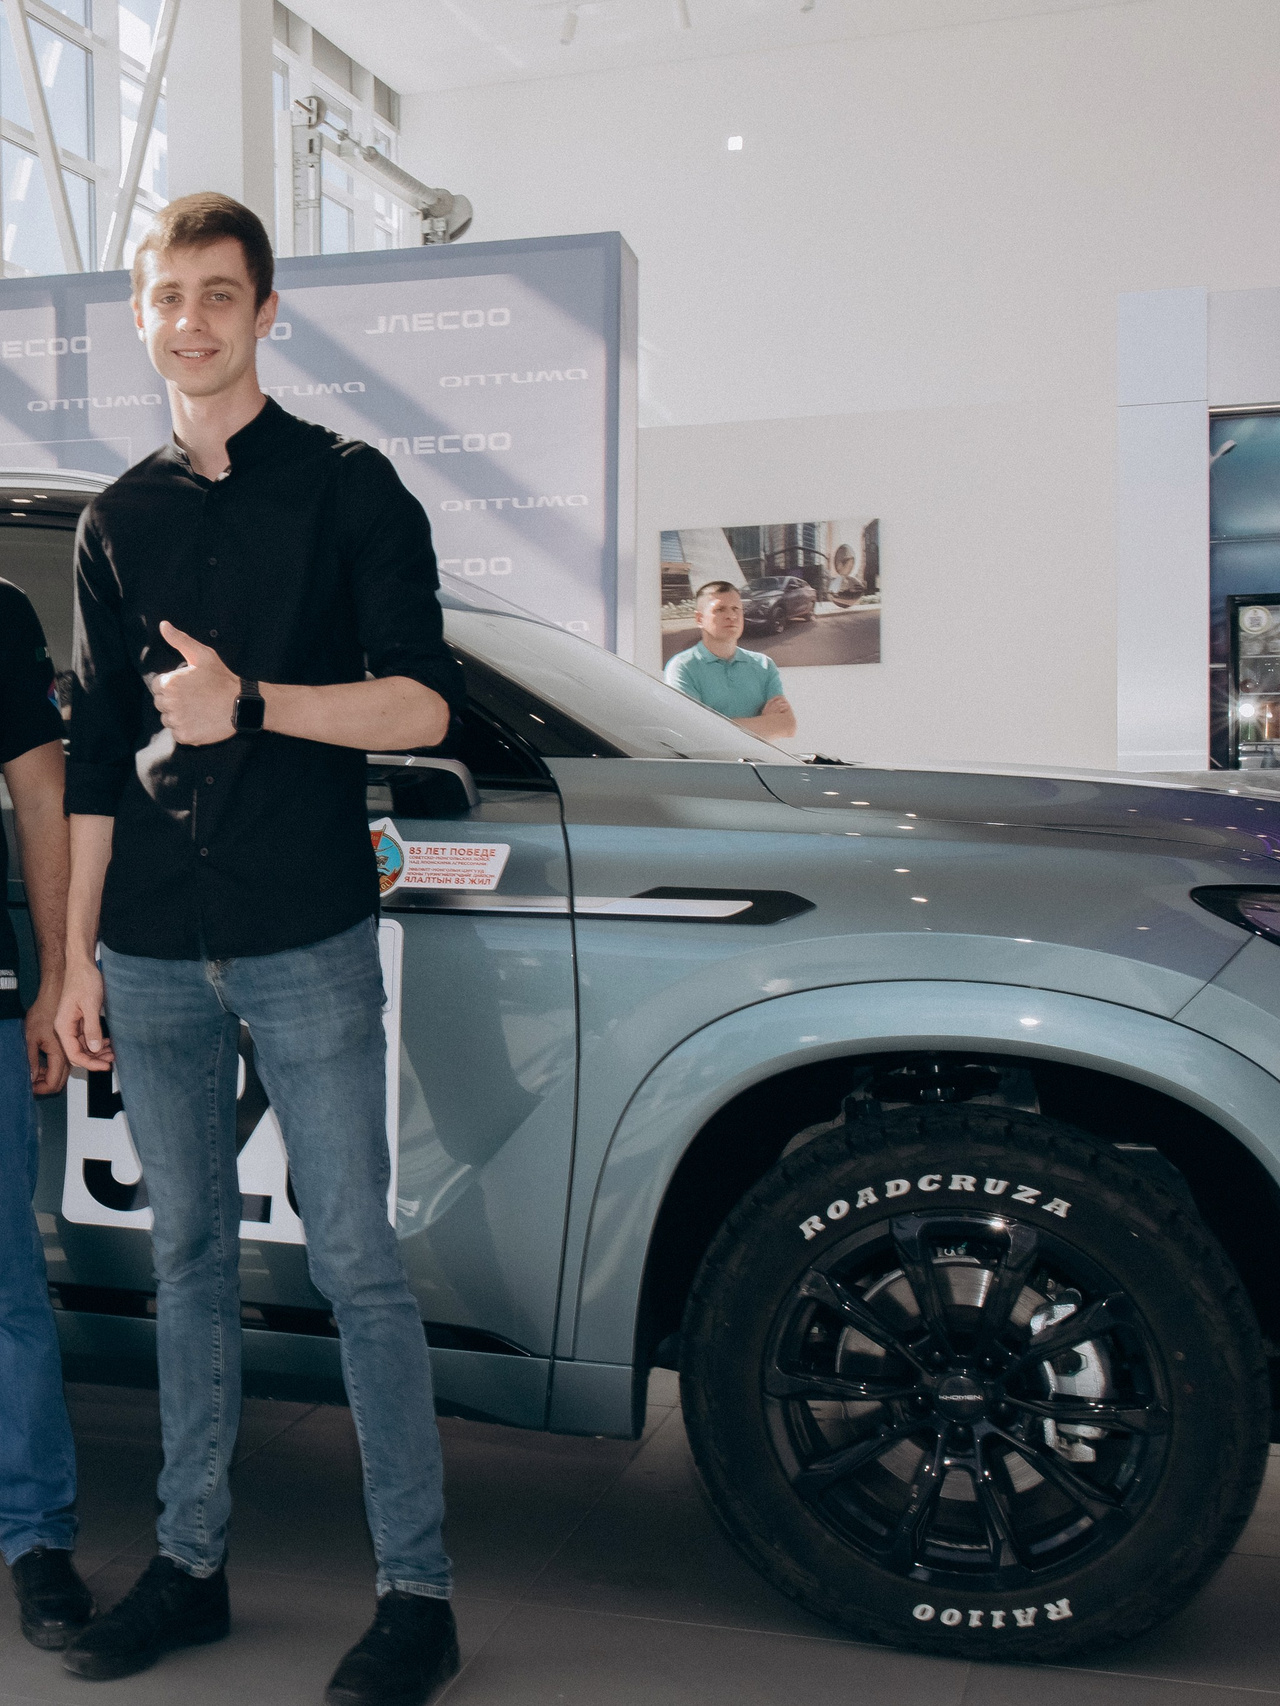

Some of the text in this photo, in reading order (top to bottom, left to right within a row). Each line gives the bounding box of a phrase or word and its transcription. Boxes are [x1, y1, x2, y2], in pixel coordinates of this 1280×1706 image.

[365, 308, 511, 335] JAECOO
[409, 847, 496, 858] 85 ЛЕТ ПОБЕДЕ
[404, 876, 452, 884] ЯЛАЛТЫН
[798, 1174, 1072, 1241] ROADCRUZA
